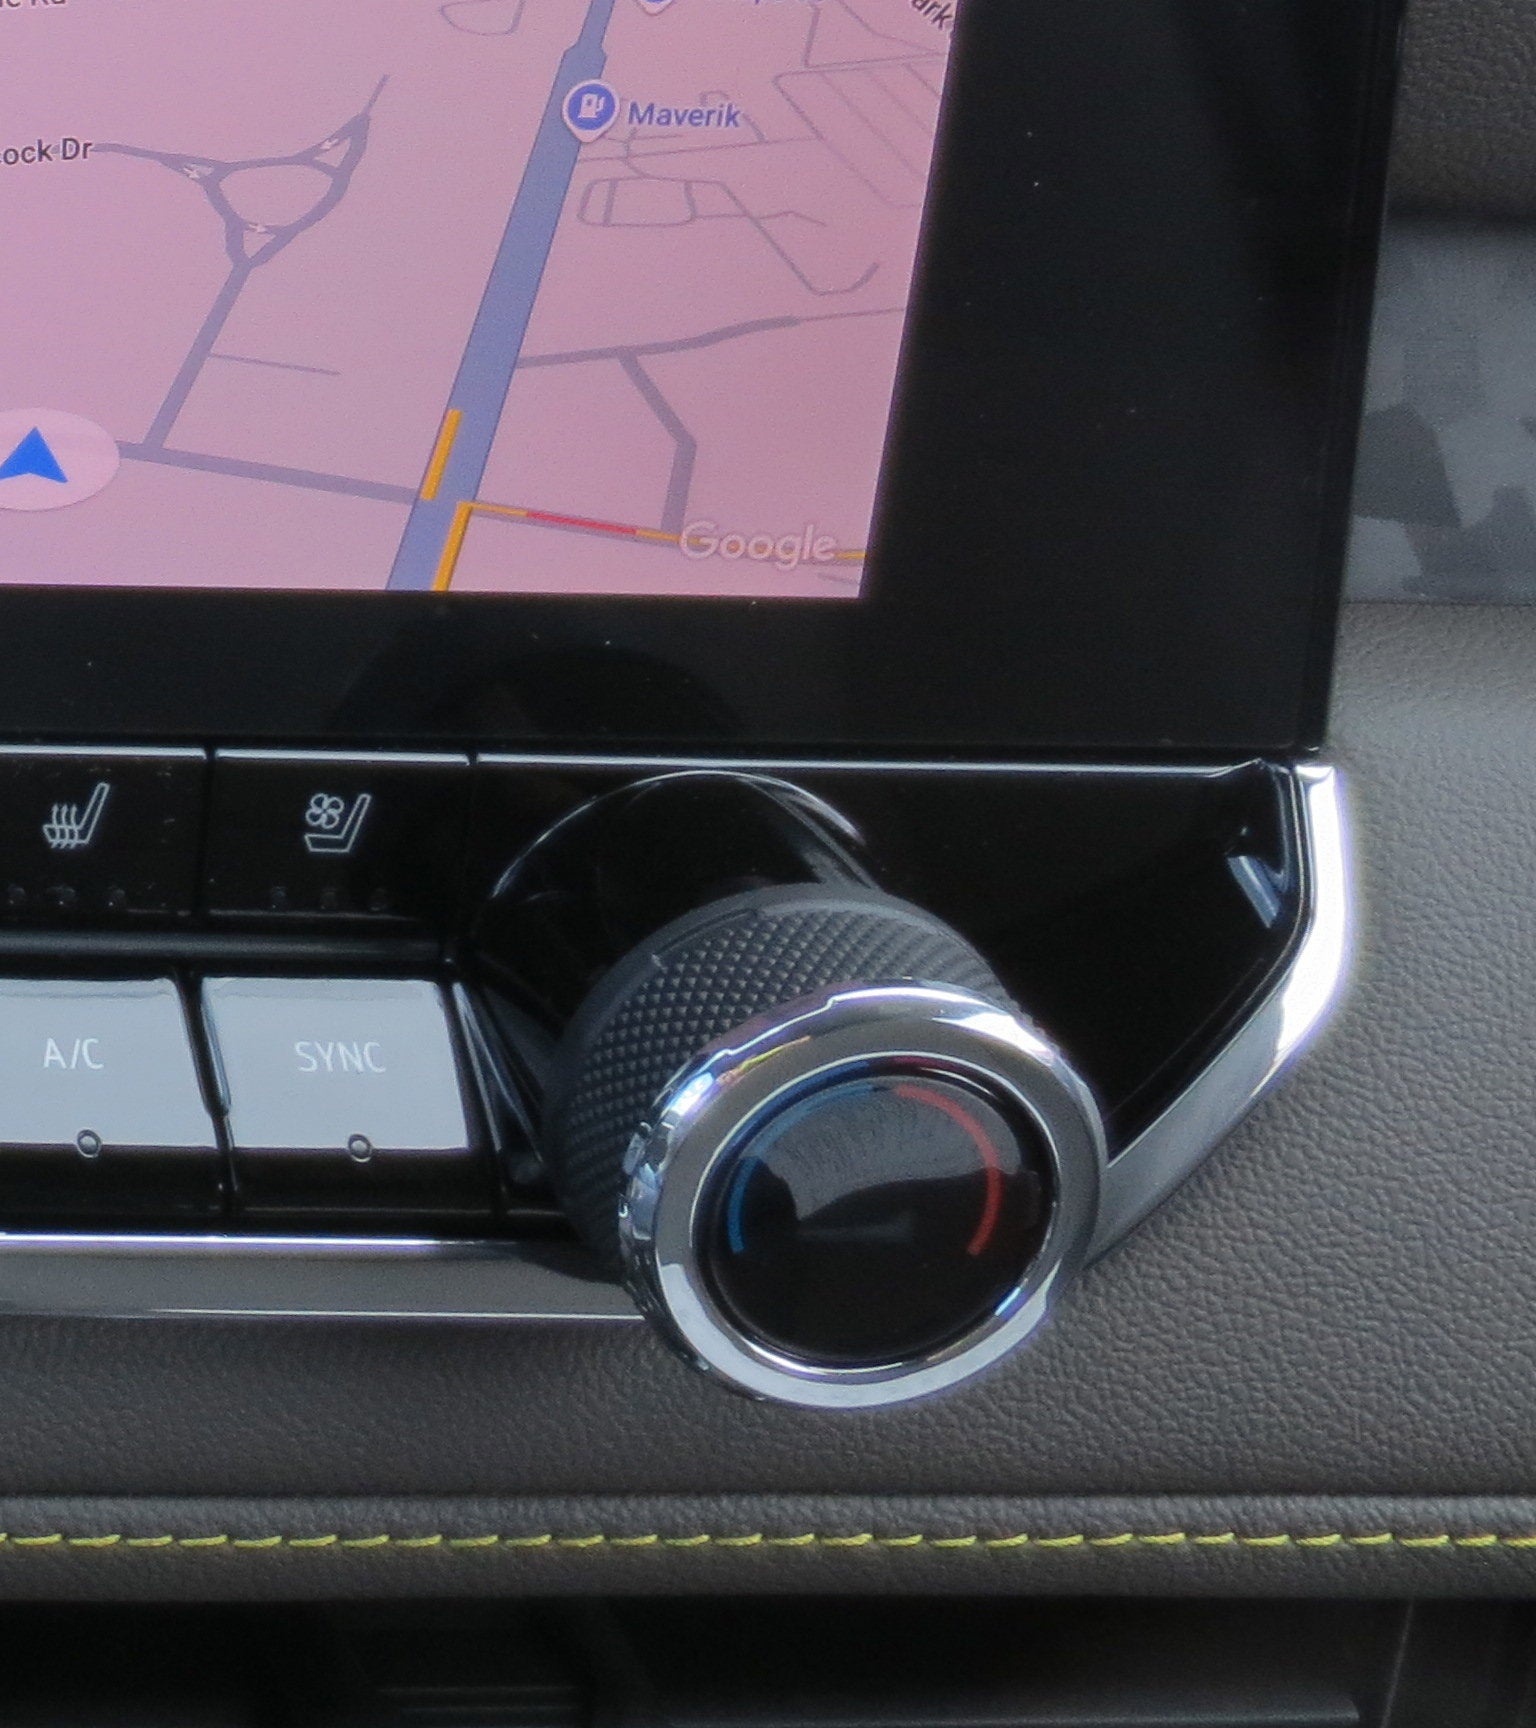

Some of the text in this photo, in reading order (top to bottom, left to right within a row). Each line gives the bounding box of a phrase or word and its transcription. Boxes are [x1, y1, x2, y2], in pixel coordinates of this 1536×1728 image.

[628, 103, 741, 129] Maverik
[61, 137, 94, 162] Dr
[679, 518, 838, 572] Google
[42, 1038, 105, 1071] A/C
[293, 1039, 388, 1074] SYNC
